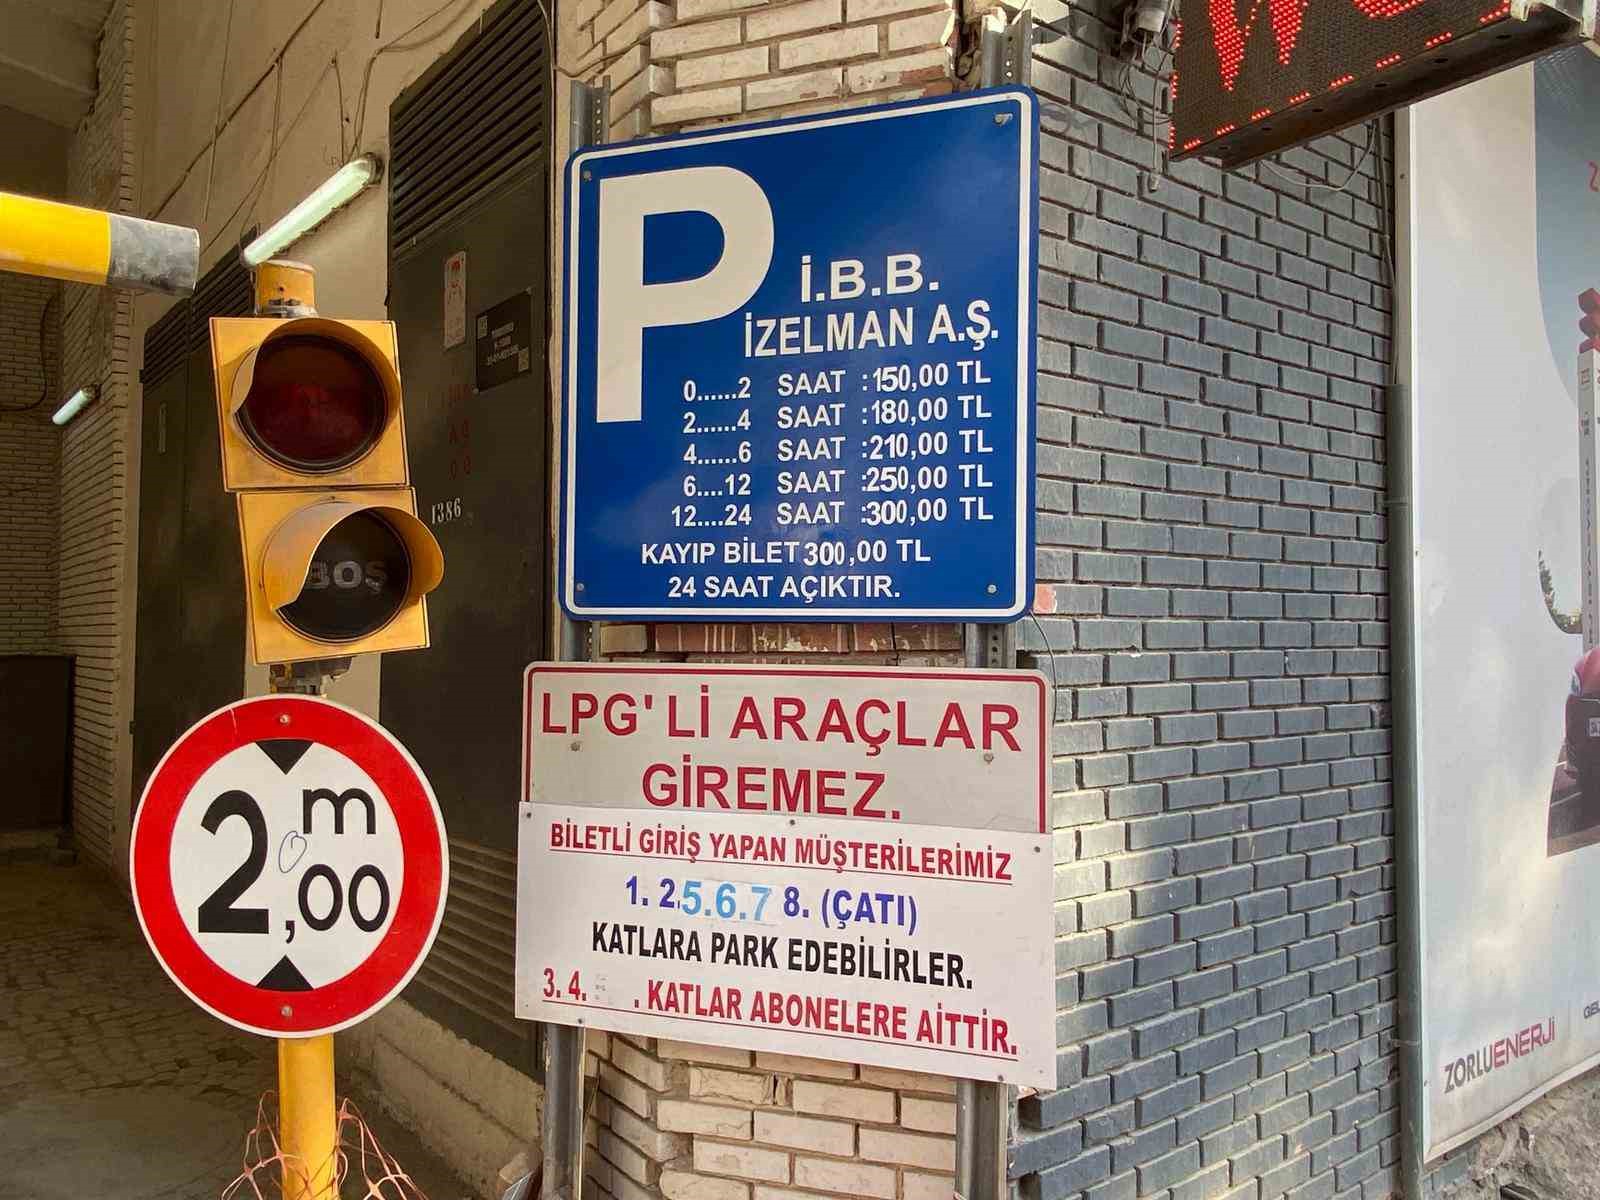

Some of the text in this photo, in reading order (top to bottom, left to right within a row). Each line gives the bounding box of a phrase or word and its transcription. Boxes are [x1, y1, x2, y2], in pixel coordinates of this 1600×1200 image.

[596, 165, 775, 423] P
[802, 254, 938, 302] İ.B.B.
[746, 300, 998, 357] İZELMAN A.Ş.
[778, 370, 845, 396] SAAT
[957, 361, 990, 384] TL
[778, 403, 845, 428] SAAT
[958, 395, 991, 418] TL
[778, 437, 845, 461] SAAT
[959, 430, 993, 453] TL
[778, 470, 845, 494] SAAT
[959, 464, 992, 487] TL
[431, 497, 462, 525] 1386
[777, 501, 845, 524] SAAT
[959, 497, 993, 520] TL
[642, 537, 930, 566] KAYIP BİLET 300,00 TL
[669, 576, 899, 603] 24 SAAT AÇIKTIR.
[730, 697, 1021, 757] ARAÇLAR
[643, 754, 900, 819] GİREMEZ.
[302, 788, 376, 834] m
[552, 818, 1012, 881] BİLETLİ GİRİŞ YAPAN MÜŞTERİLERİMİZ
[626, 876, 648, 906] 1.
[784, 887, 808, 918] 8.
[822, 889, 916, 936] (ÇATI)
[593, 922, 972, 989] KATLARA PARK EDEBİLİRLER.
[544, 968, 560, 998] 3.
[569, 971, 586, 1001] 4.
[647, 979, 743, 1022] KATLAR
[750, 989, 908, 1041] ABONELERE
[916, 1003, 1018, 1056] AİTTİR.
